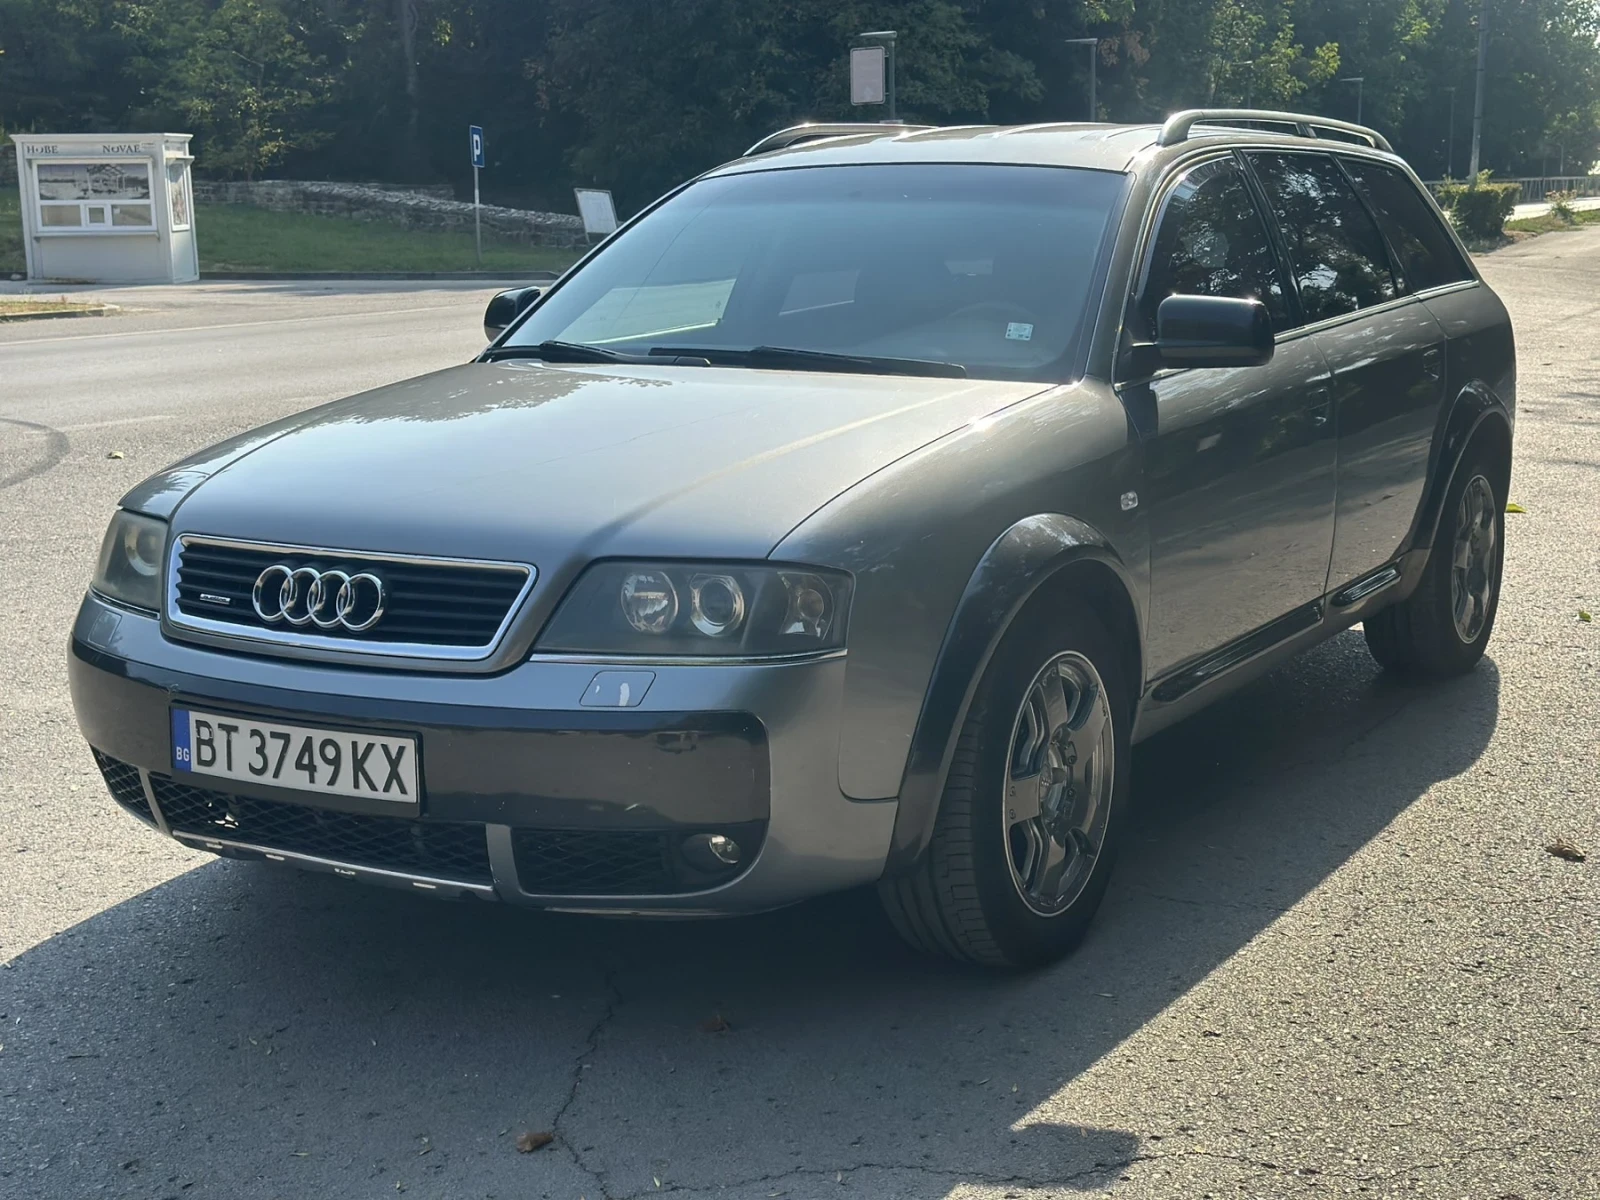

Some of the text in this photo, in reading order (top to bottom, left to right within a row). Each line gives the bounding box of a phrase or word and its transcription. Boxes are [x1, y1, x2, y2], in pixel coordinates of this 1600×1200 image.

[473, 134, 481, 162] P
[176, 747, 189, 762] BG
[195, 719, 408, 795] BT 3749 KX
